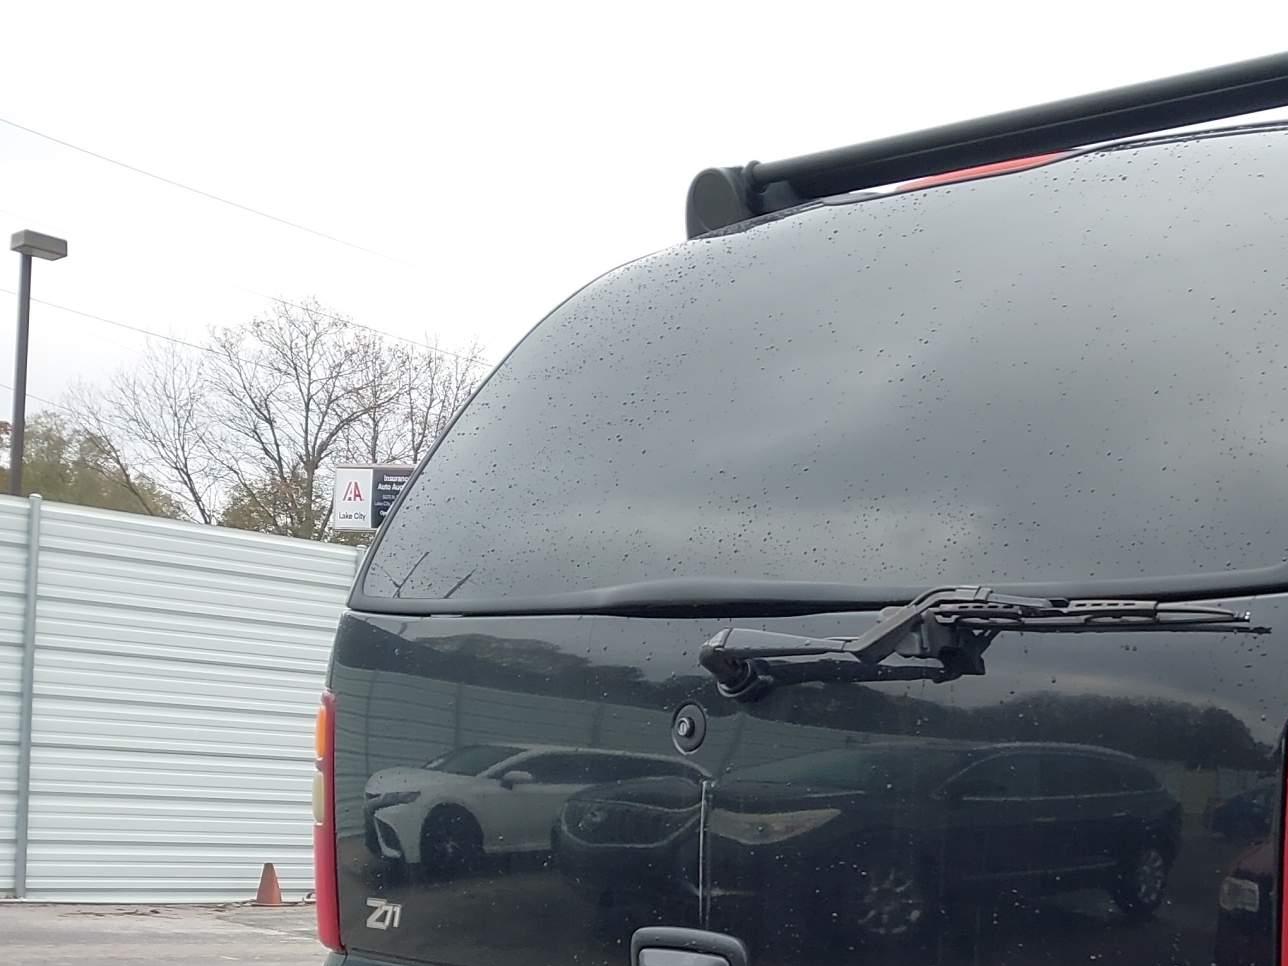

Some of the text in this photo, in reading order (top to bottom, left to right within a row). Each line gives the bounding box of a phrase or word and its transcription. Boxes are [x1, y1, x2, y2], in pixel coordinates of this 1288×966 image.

[338, 511, 367, 522] Lake City
[366, 897, 402, 930] Z71
